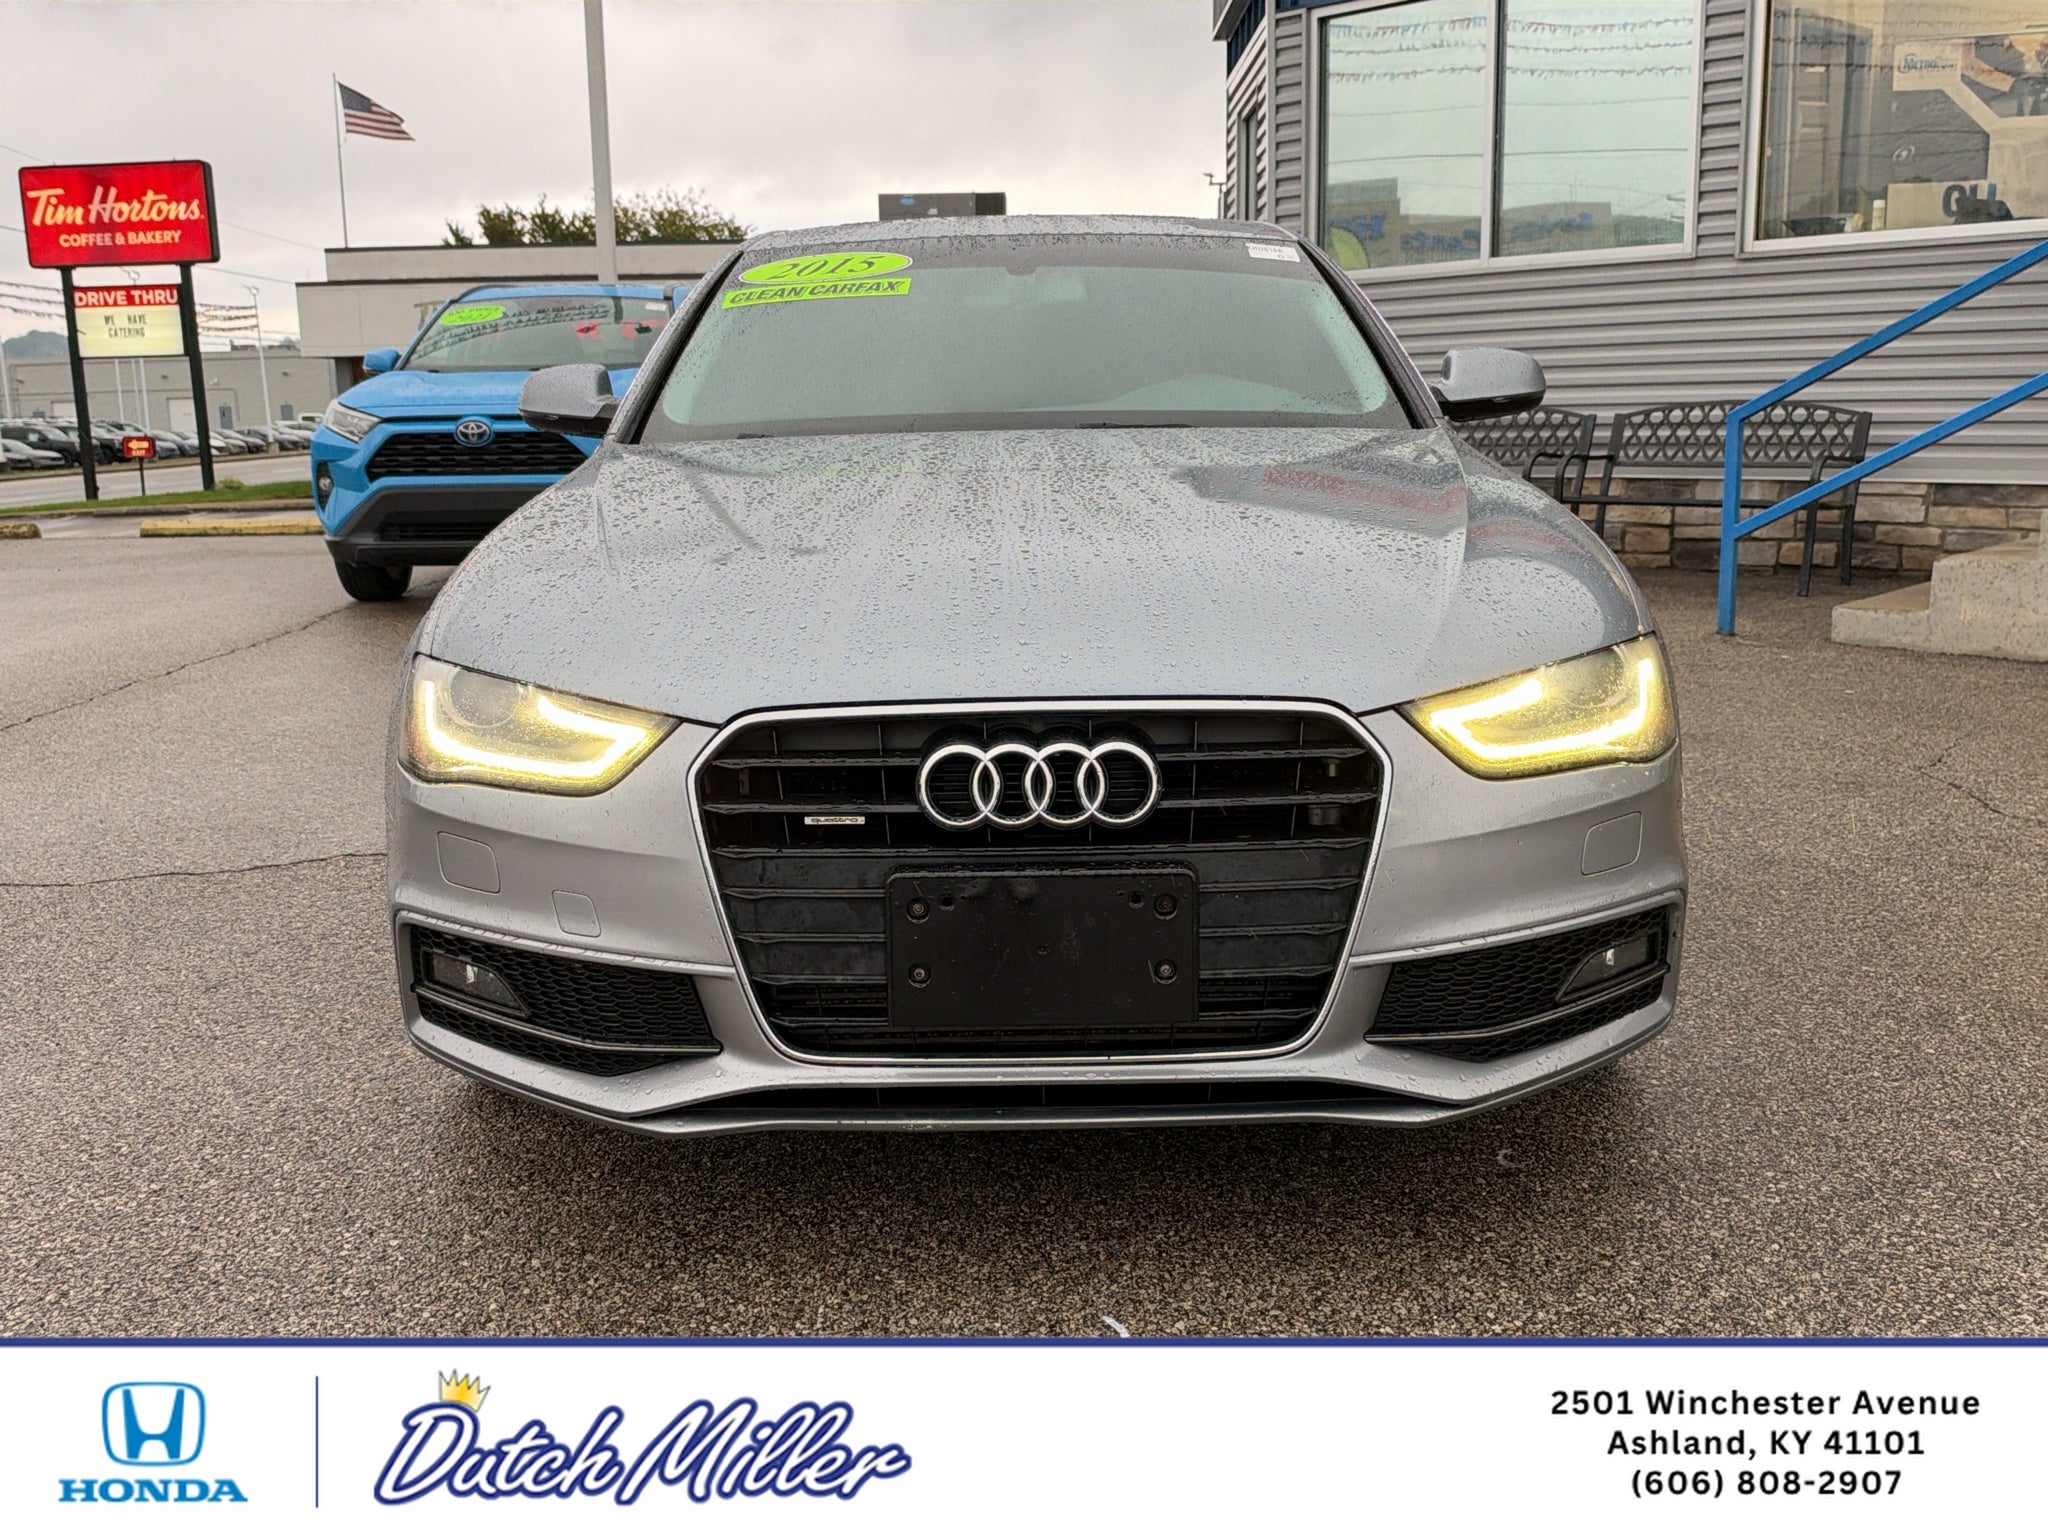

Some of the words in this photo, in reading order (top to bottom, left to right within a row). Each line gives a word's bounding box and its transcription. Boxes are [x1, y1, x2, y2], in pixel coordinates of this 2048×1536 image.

[26, 187, 85, 227] Tim
[58, 232, 114, 248] COFFEE
[114, 231, 126, 246] &
[127, 229, 183, 245] BAKERY
[766, 254, 885, 281] 2015
[74, 291, 128, 307] DRIVE
[130, 288, 178, 304] THRU
[729, 286, 808, 304] CLEAN
[808, 280, 902, 296] CARFAX
[103, 314, 116, 326] WE
[127, 313, 148, 325] HAVE
[108, 326, 146, 338] CATERING
[131, 449, 146, 457] EXIT
